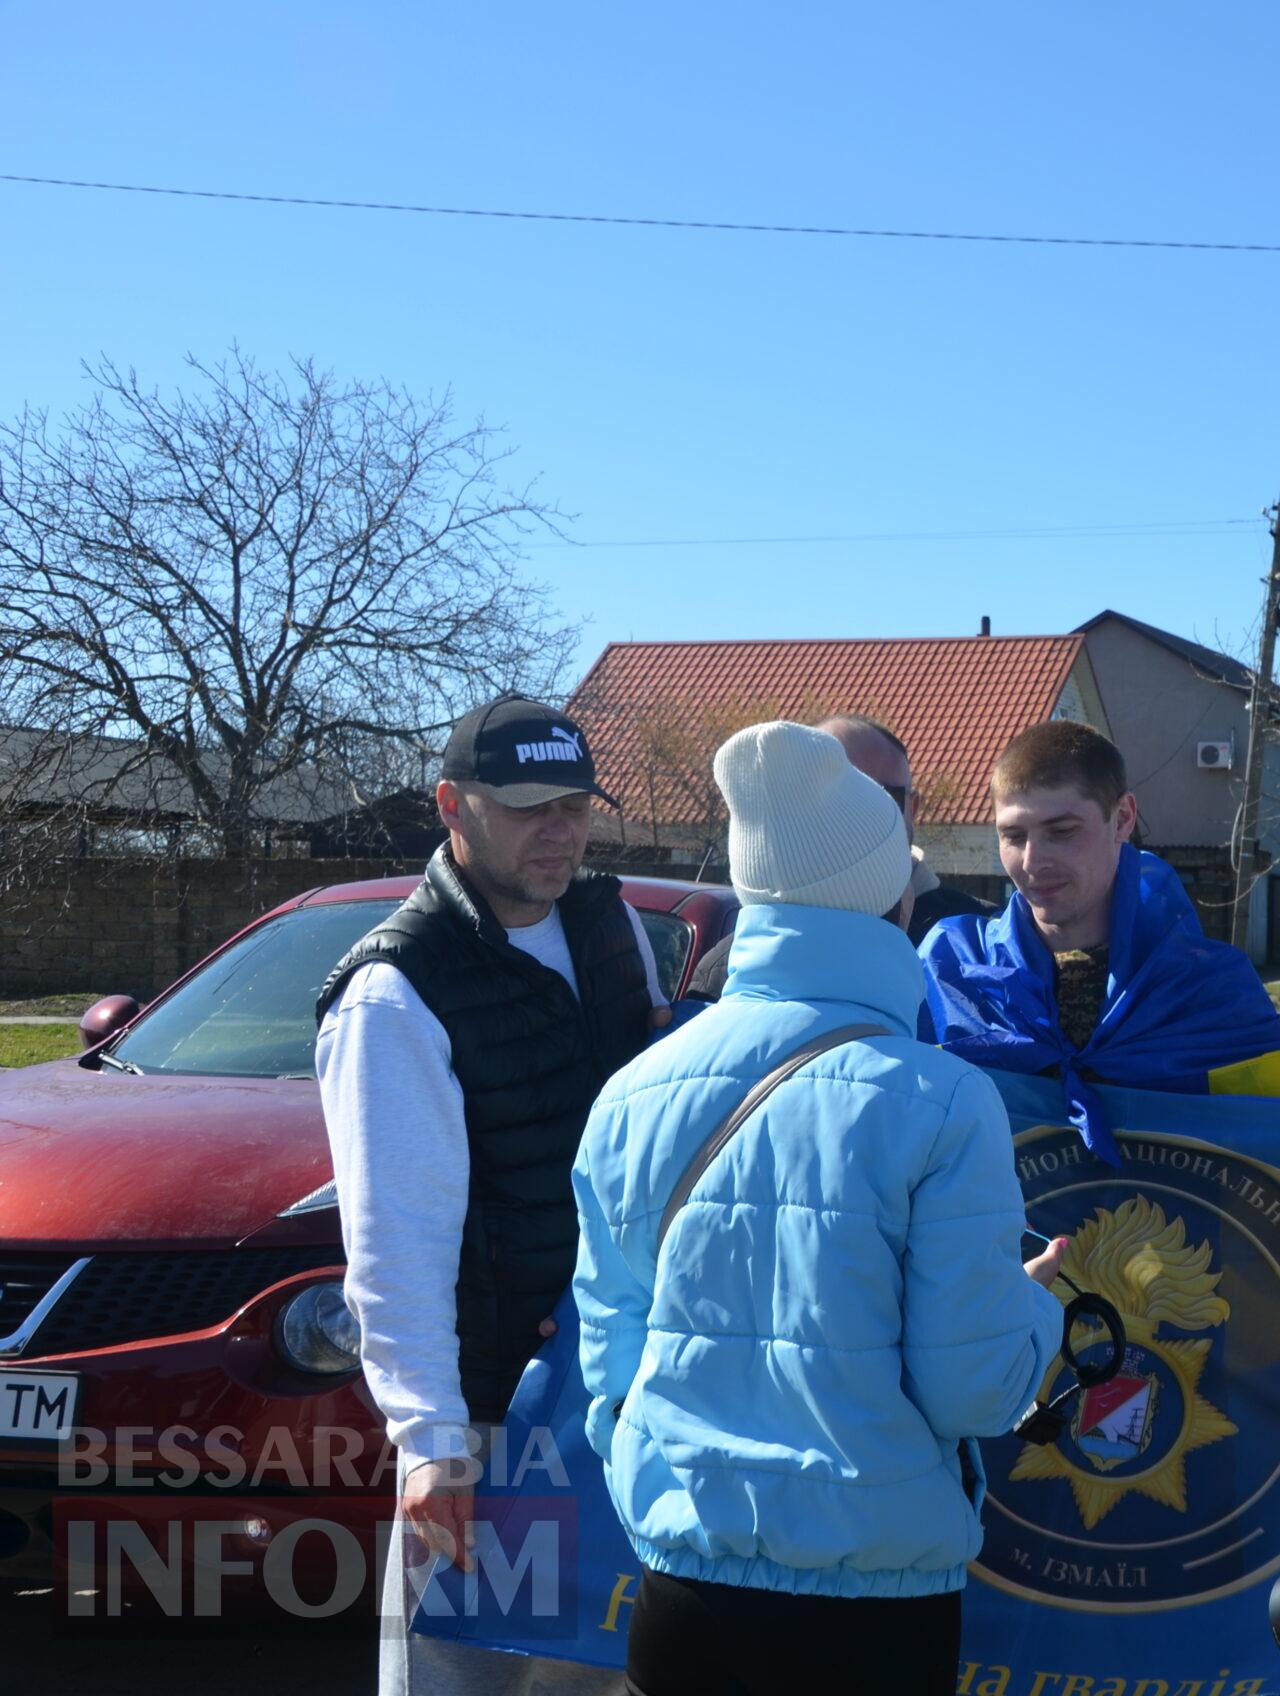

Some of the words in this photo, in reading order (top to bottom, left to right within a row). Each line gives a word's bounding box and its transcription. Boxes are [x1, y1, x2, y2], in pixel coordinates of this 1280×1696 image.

[515, 741, 578, 763] PUMA
[6, 1383, 69, 1430] TM
[1040, 1557, 1149, 1588] ІЗМАЇЛ
